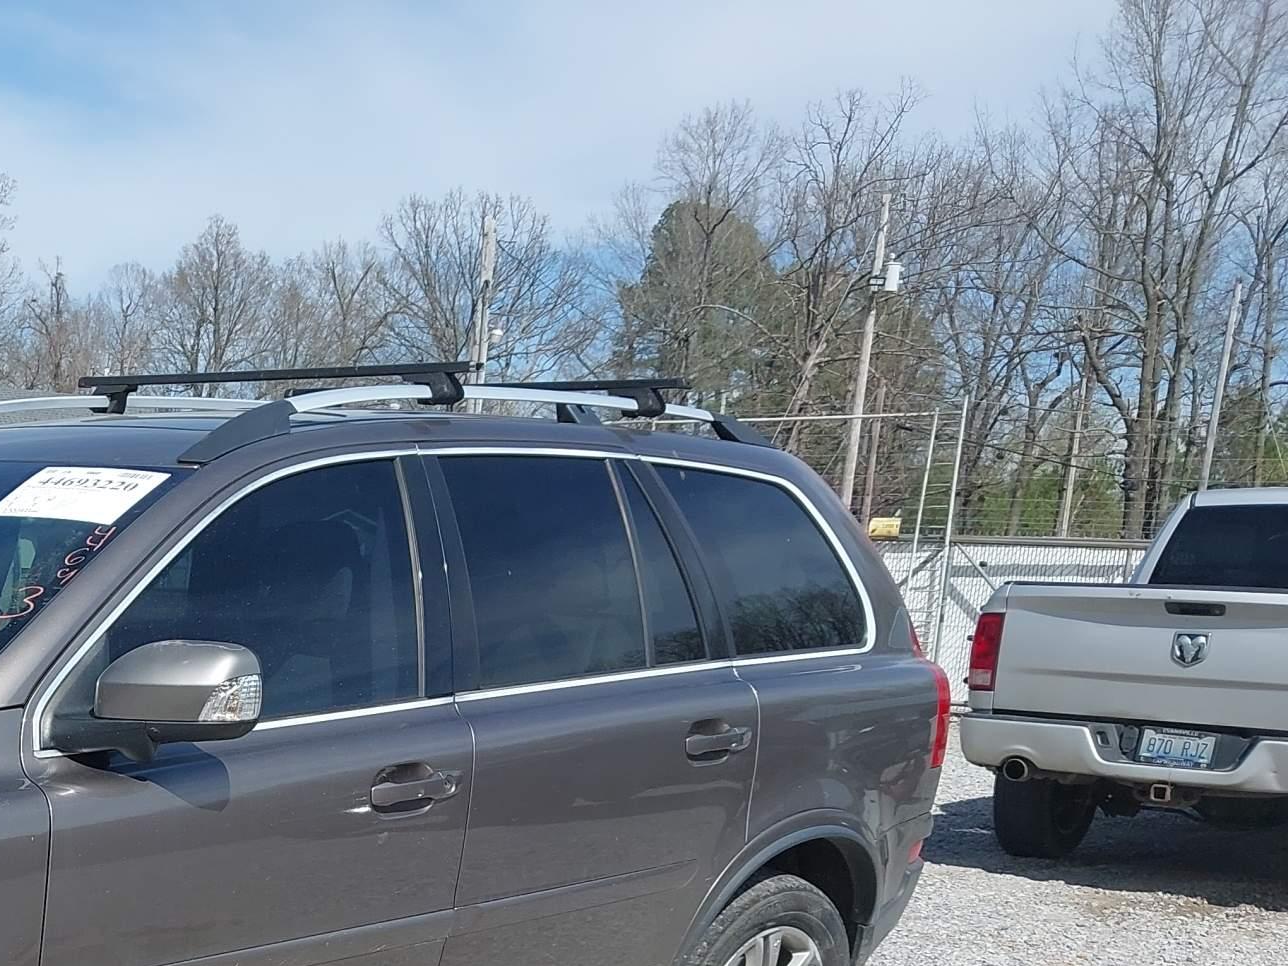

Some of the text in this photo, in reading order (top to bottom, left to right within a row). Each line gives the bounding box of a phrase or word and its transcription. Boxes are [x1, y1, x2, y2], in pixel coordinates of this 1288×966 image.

[38, 476, 139, 492] 44693220
[1147, 737, 1208, 759] 870 RJZ
